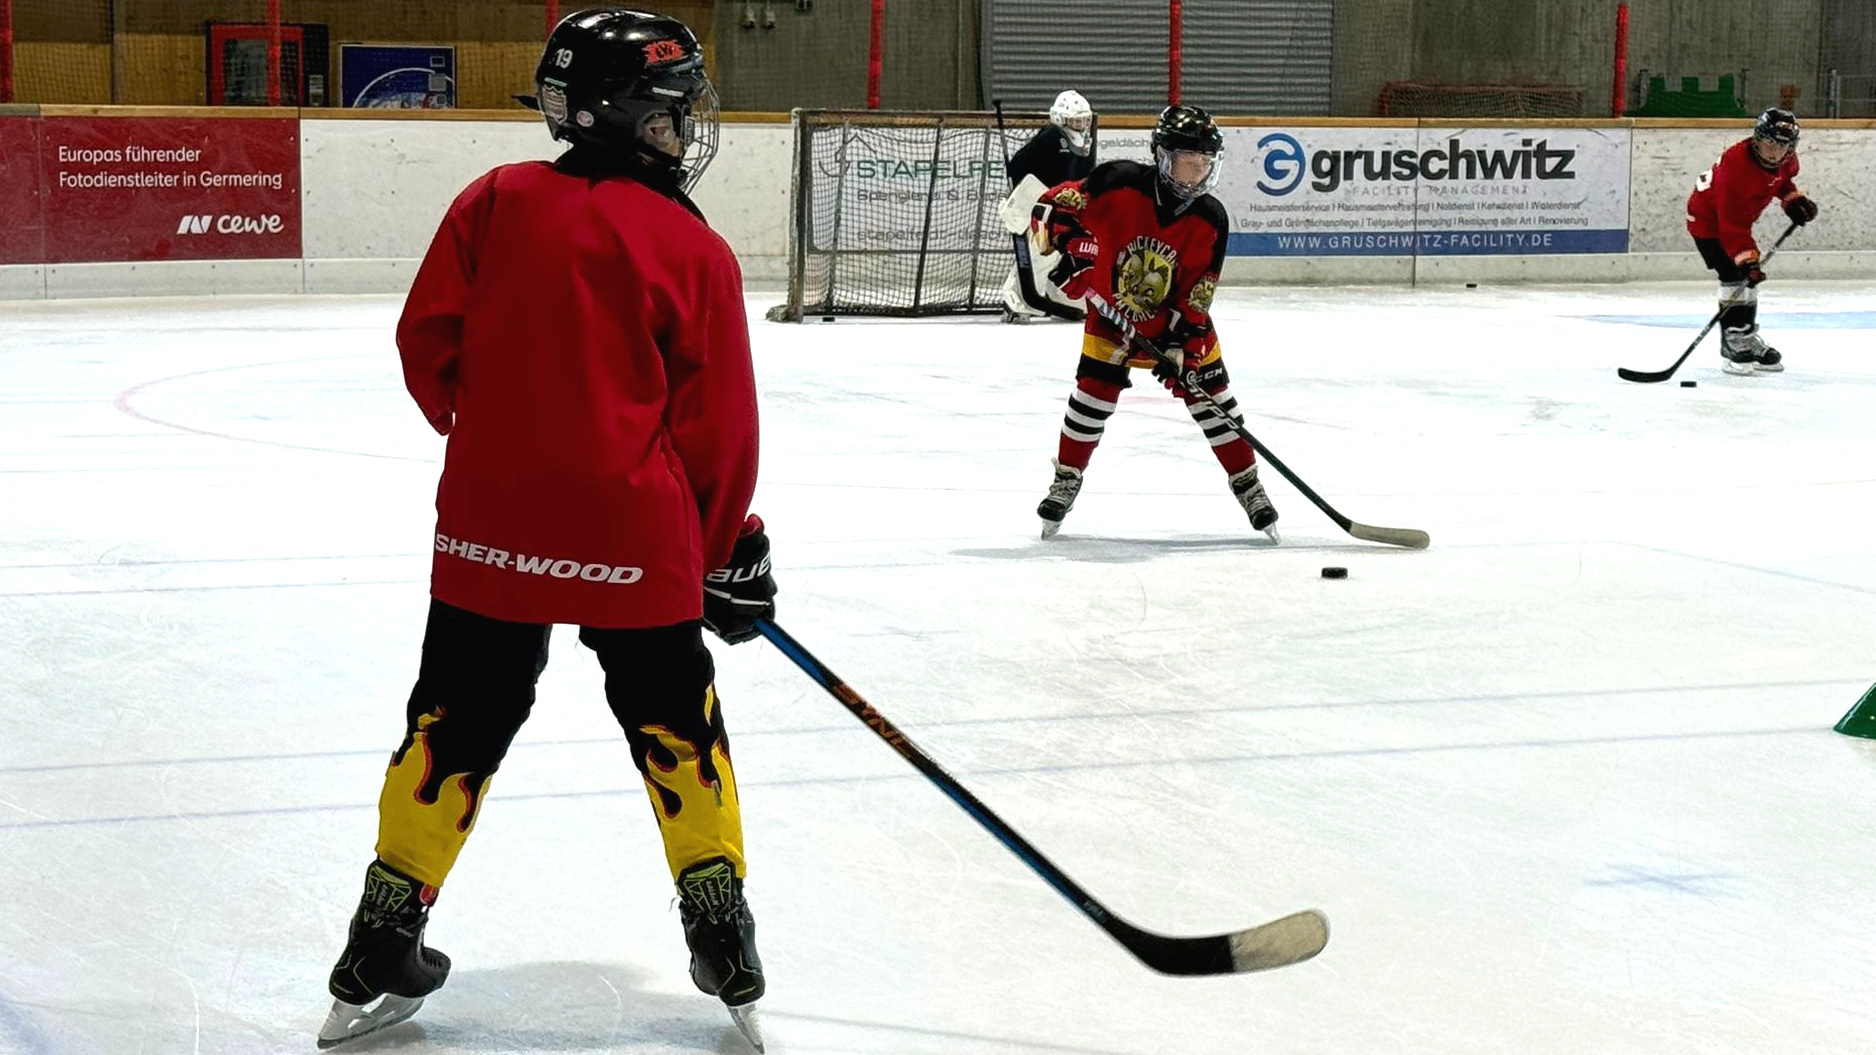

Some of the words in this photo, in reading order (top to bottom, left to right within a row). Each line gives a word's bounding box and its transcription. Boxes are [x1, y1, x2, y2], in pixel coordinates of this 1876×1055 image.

[555, 47, 573, 68] 19
[58, 145, 122, 165] Europas
[125, 145, 202, 162] führender
[857, 159, 1005, 179] STAPELFE
[1311, 138, 1576, 193] gruschwitz
[59, 171, 180, 188] Fotodienstleiter
[183, 170, 197, 187] in
[200, 170, 283, 190] Germering
[1353, 186, 1420, 197] FACILITY
[1429, 185, 1529, 197] MANAGEMENT
[1249, 202, 1331, 213] Hausmeisterservice
[1436, 202, 1476, 212] Notdienst
[216, 213, 284, 234] cewe
[1266, 218, 1283, 228] und
[1519, 216, 1532, 226] Art
[1537, 216, 1589, 227] Renovierung
[1277, 233, 1553, 249] WWW.GRUSCHWITZ-FACILITY.DE
[434, 532, 644, 585] SHER-WOOD
